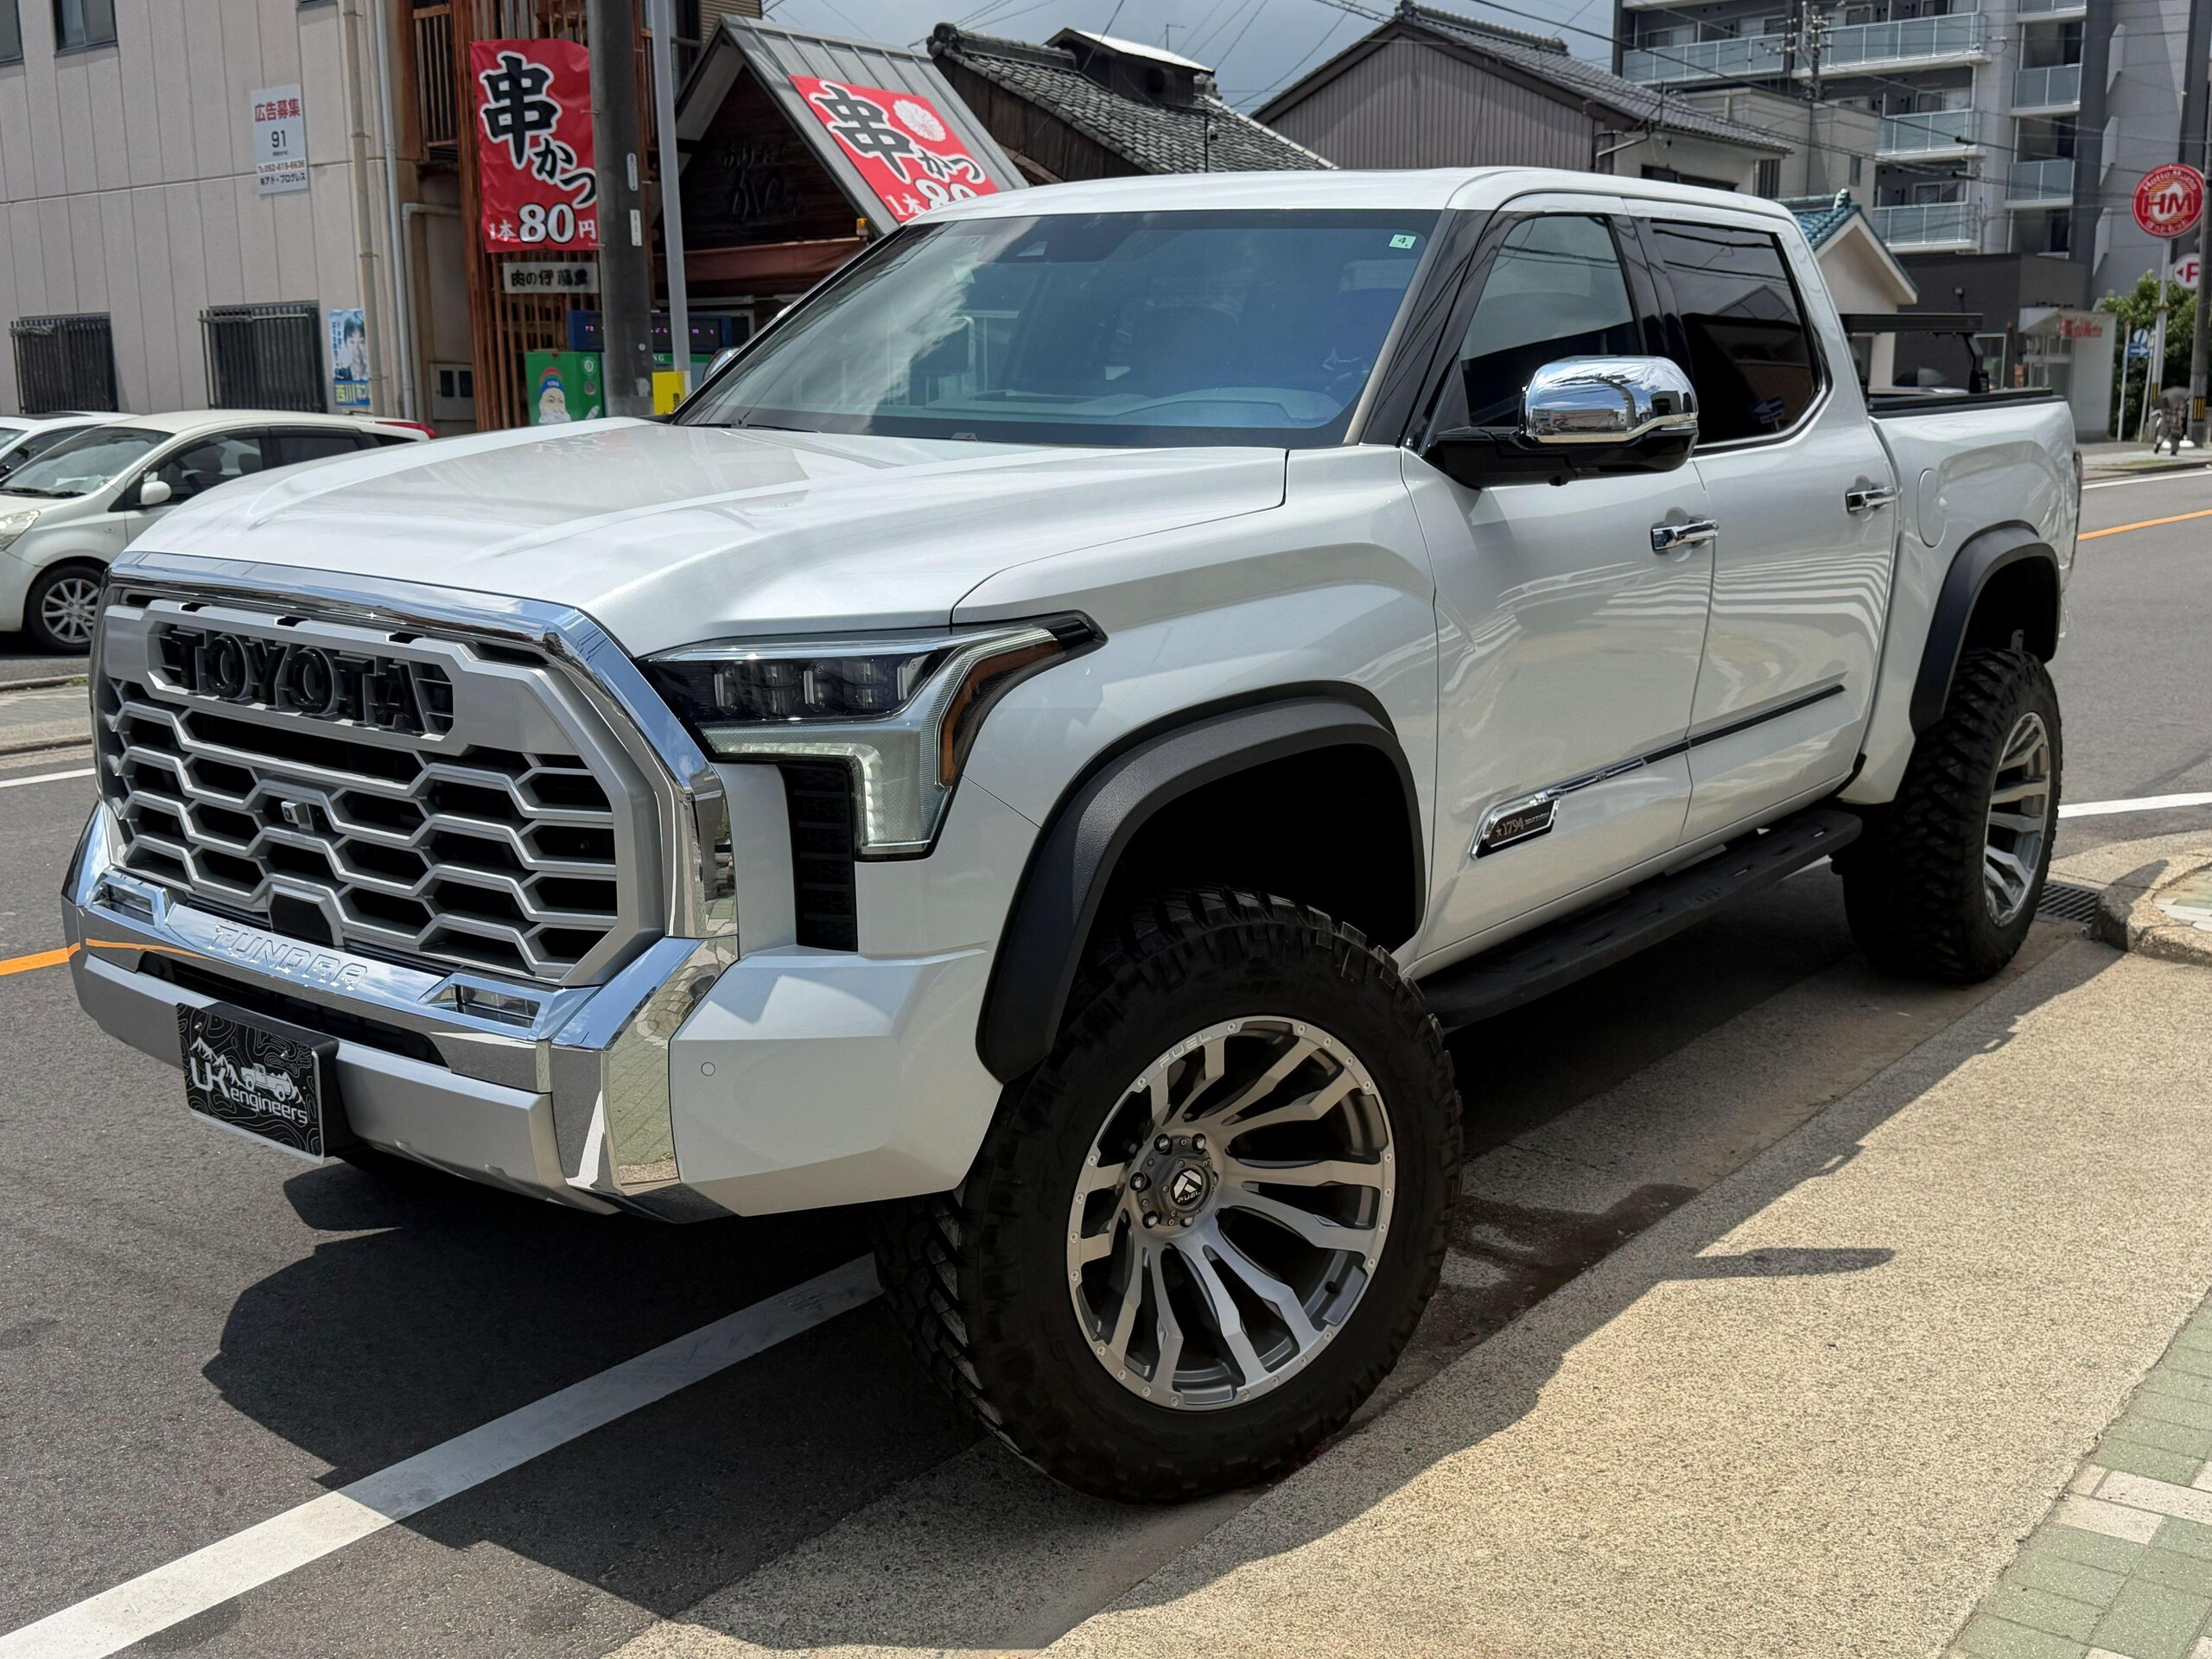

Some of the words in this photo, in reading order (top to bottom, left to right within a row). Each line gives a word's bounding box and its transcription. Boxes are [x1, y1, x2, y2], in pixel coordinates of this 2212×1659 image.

[254, 98, 301, 122] 広告募集
[271, 130, 286, 148] 91
[480, 51, 597, 209] 串かつ
[809, 79, 986, 184] 串かつ
[2142, 192, 2194, 216] HM
[489, 203, 596, 244] 1本80円
[159, 629, 427, 734] TOYOTA
[1502, 817, 1524, 836] 1794
[207, 924, 367, 991] TUNDRA
[1159, 1033, 1211, 1069] FUEL
[190, 1056, 230, 1098] UK
[230, 1087, 308, 1124] engineers
[1177, 1191, 1201, 1203] FUEL
